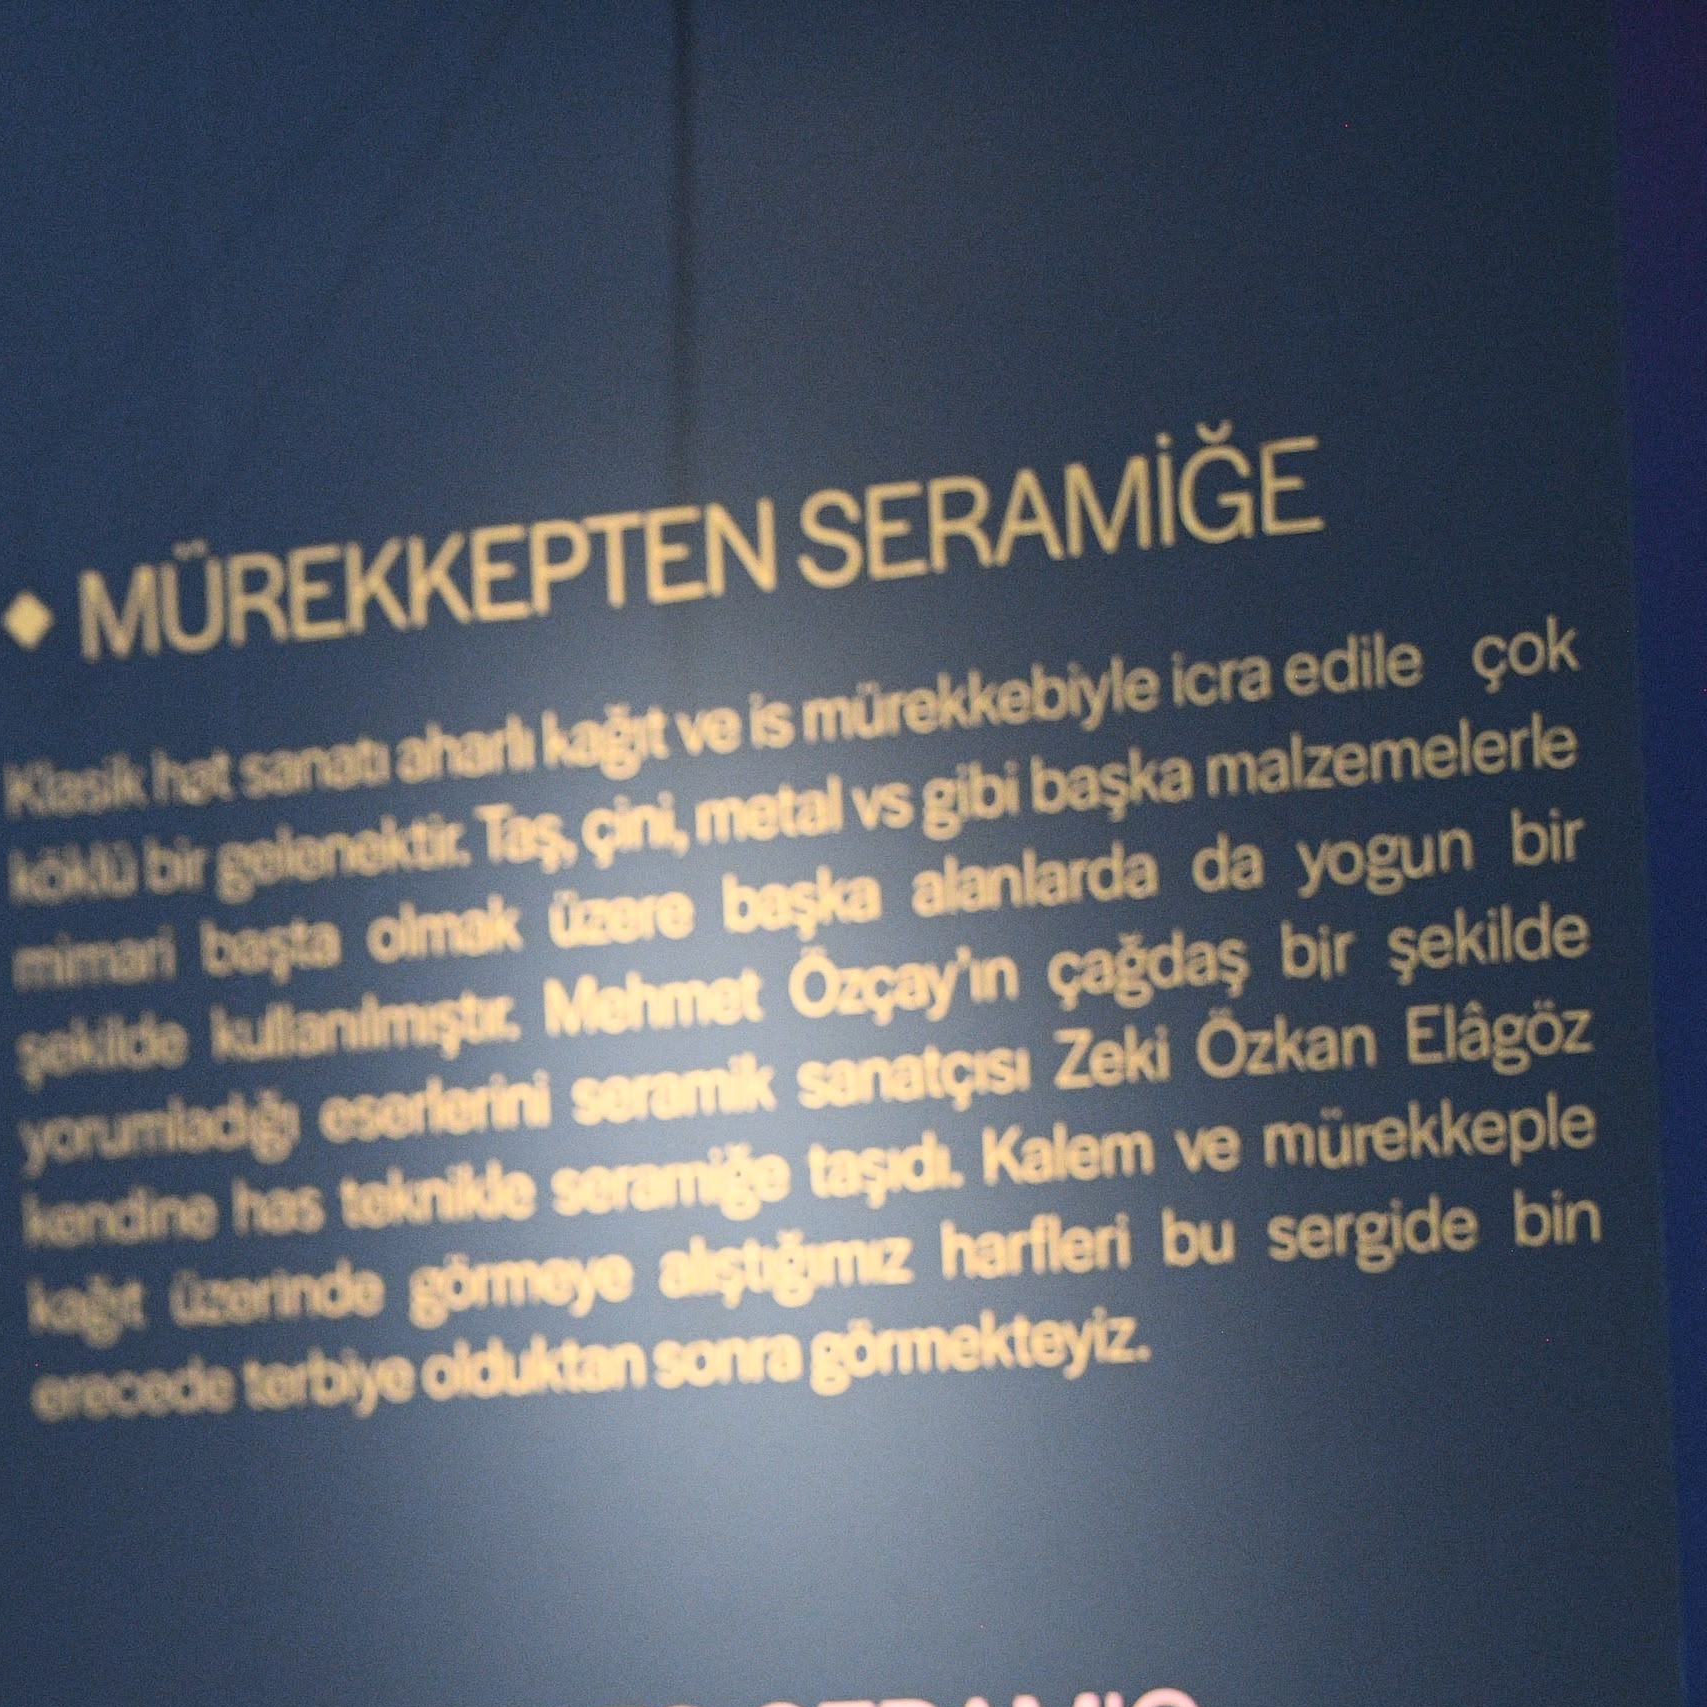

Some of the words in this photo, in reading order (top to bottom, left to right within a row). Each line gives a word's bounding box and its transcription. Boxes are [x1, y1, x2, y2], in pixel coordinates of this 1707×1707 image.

[80, 498, 777, 658] MÜREKKEPTEN
[799, 422, 1324, 588] SERAMİĞE
[803, 657, 1160, 742] mürekkebiyle
[1172, 653, 1272, 707] icra
[1284, 632, 1423, 697] edile
[1472, 615, 1579, 693] çok
[852, 782, 914, 829] vs
[923, 762, 1020, 841] gibi
[1031, 748, 1193, 821] başka
[1206, 712, 1578, 796] malzemelerle
[912, 842, 1159, 917] alanlarda
[1192, 833, 1264, 893] da
[1511, 809, 1584, 866] bir
[1047, 930, 1250, 1011] çağdaş
[1281, 921, 1353, 979] bir
[1388, 902, 1589, 985] şekilde
[797, 1045, 1031, 1111] sanatçısı
[1055, 1026, 1170, 1090] Zeki
[1196, 1012, 1377, 1079] Özkan
[982, 1122, 1155, 1184] Kalem
[1175, 1125, 1241, 1172] ve
[1264, 1092, 1596, 1169] mürekkeple
[941, 1213, 1131, 1279] harfleri
[1162, 1208, 1235, 1267] bu
[1267, 1195, 1478, 1273] sergide
[1514, 1189, 1601, 1247] bin
[810, 1306, 1151, 1396] görmekteyiz.
